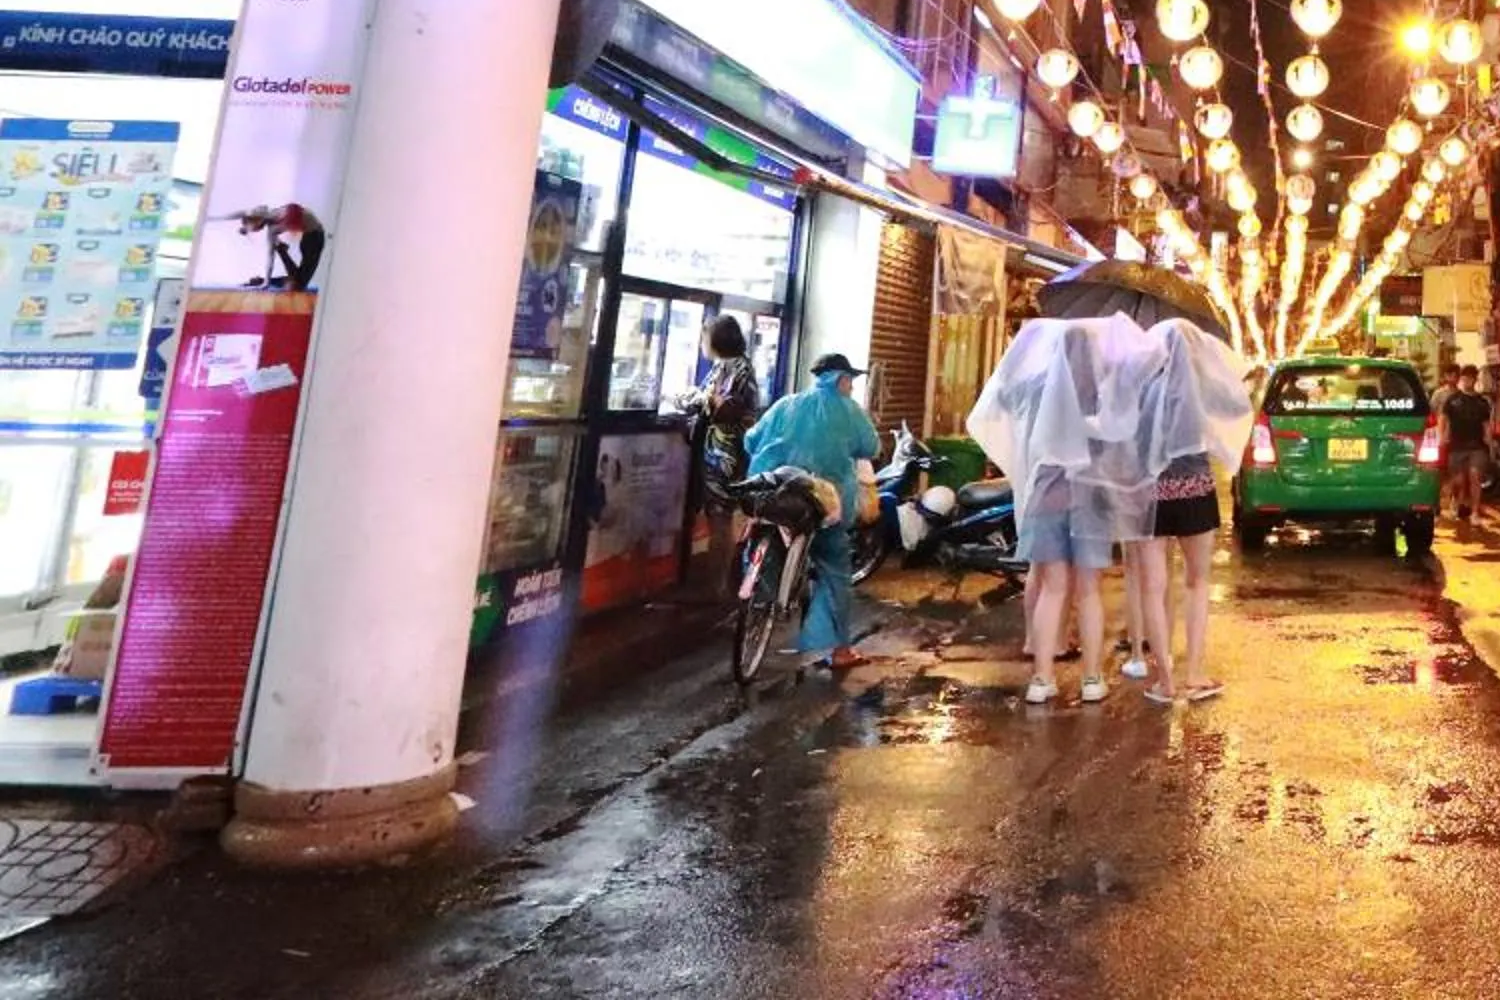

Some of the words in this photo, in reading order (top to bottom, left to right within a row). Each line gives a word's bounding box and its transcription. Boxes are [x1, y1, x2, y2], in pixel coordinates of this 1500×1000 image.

[19, 23, 65, 43] KÍNH
[69, 26, 121, 46] CHÀO
[125, 28, 166, 48] QUÝ
